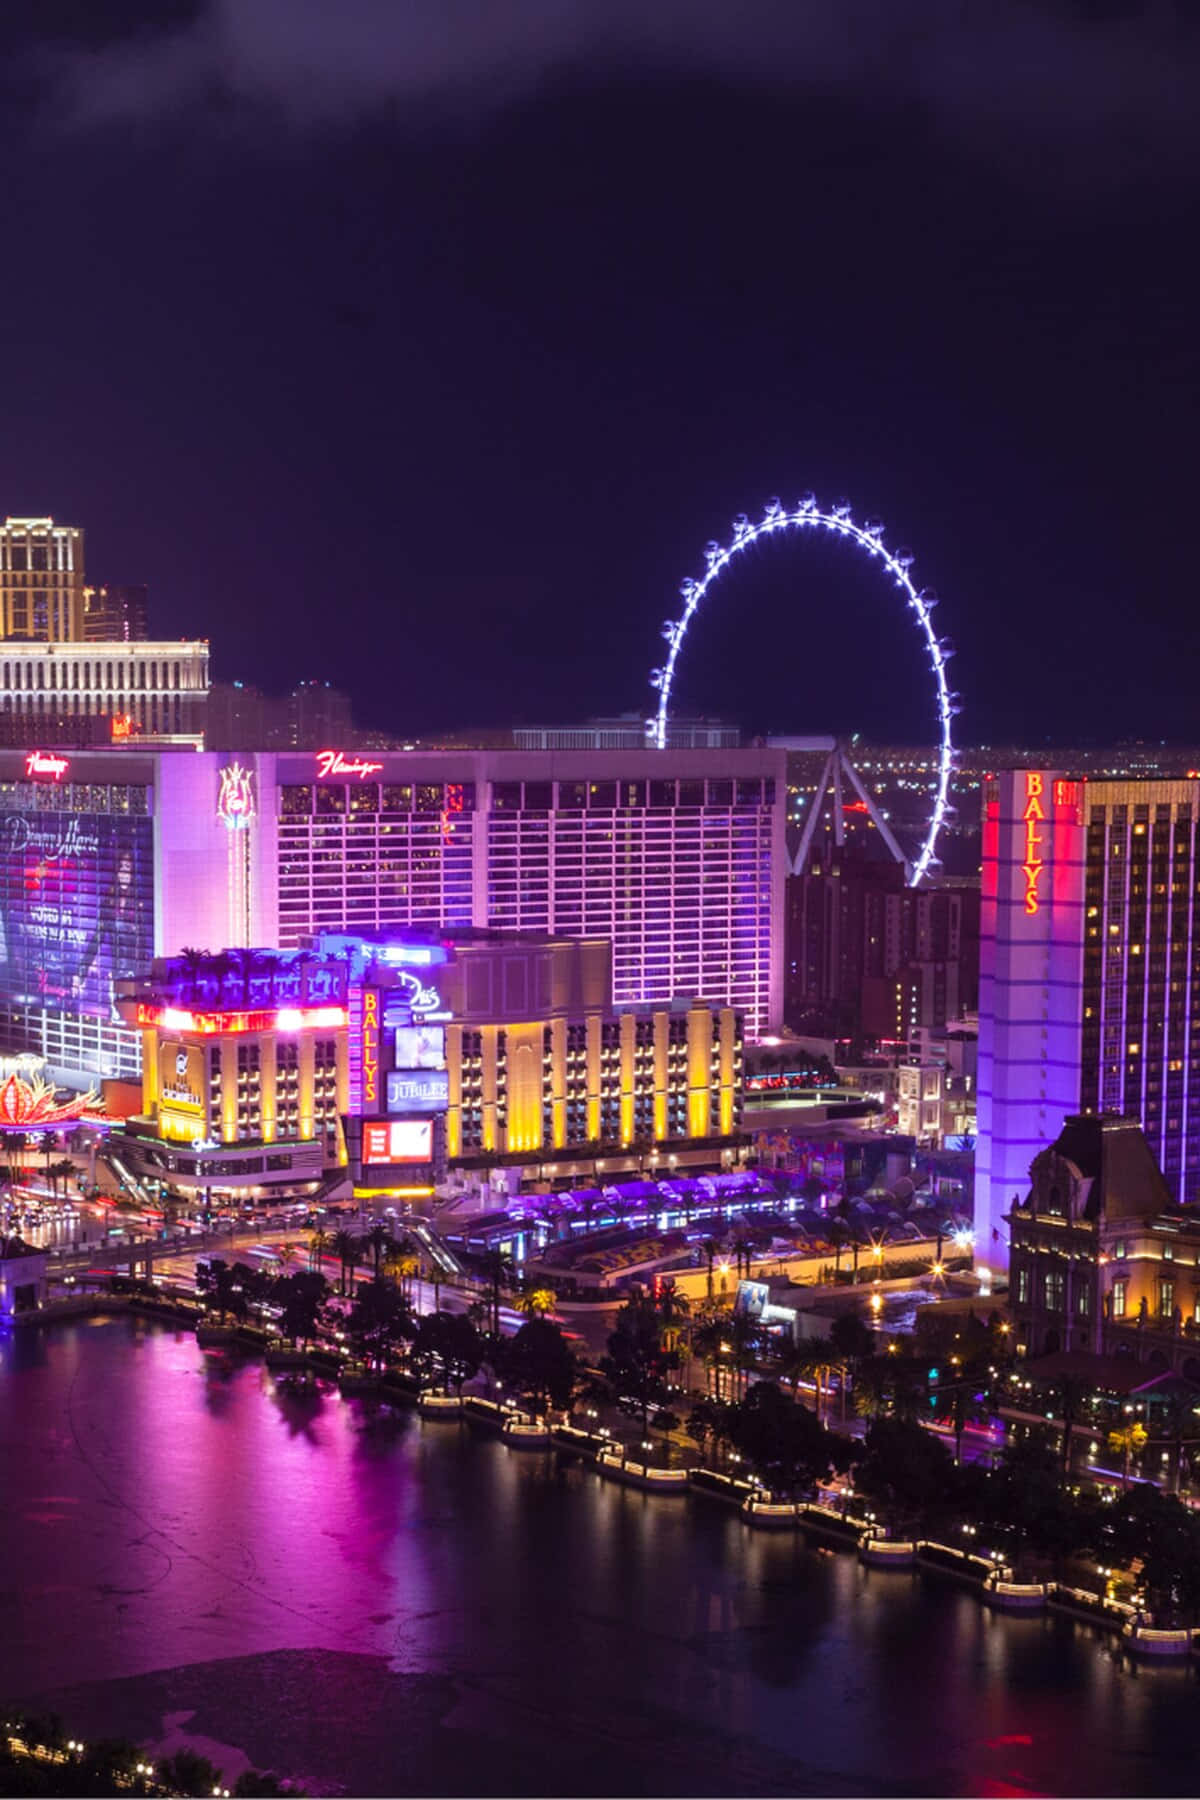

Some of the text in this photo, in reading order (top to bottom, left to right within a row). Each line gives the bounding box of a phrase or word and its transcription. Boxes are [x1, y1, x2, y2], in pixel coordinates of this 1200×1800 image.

[316, 751, 383, 779] Flamingo
[1022, 773, 1044, 914] BALLYS
[363, 992, 377, 1102] BALLYS
[387, 1082, 448, 1103] JUBILEE
